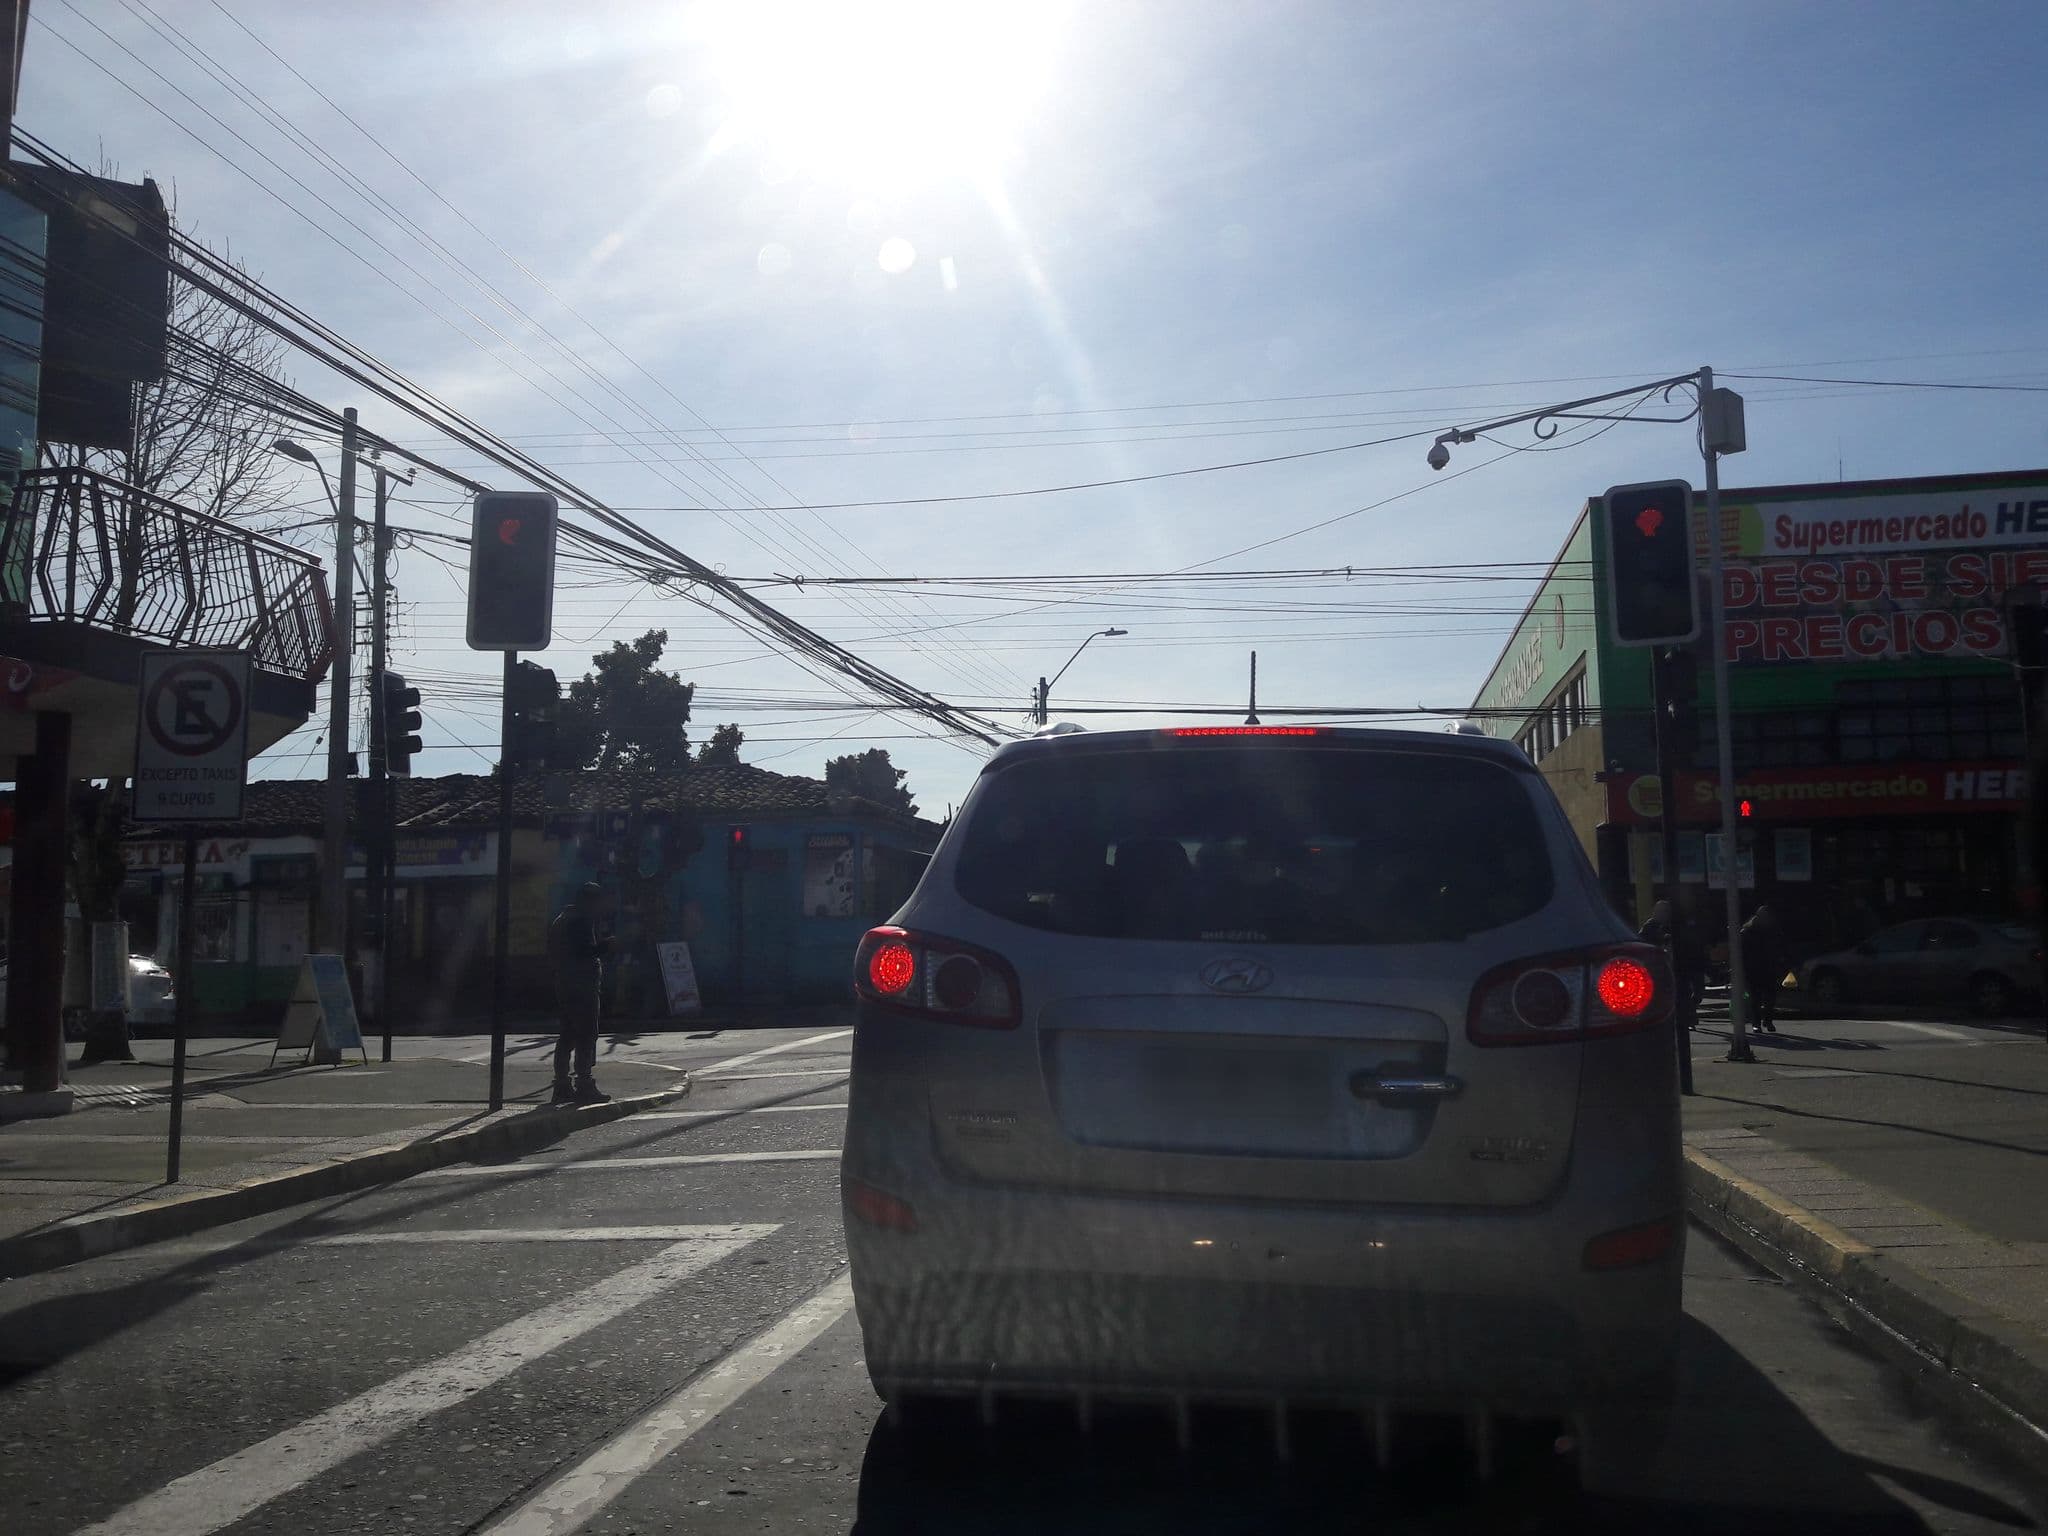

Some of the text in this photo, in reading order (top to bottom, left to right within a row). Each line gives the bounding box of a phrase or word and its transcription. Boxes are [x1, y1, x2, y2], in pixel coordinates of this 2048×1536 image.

[1775, 505, 1987, 554] Supermercado
[1721, 557, 1926, 609] DESDE
[1724, 608, 2001, 663] PRECIOS
[142, 767, 237, 781] EXCEPTO TAXIS
